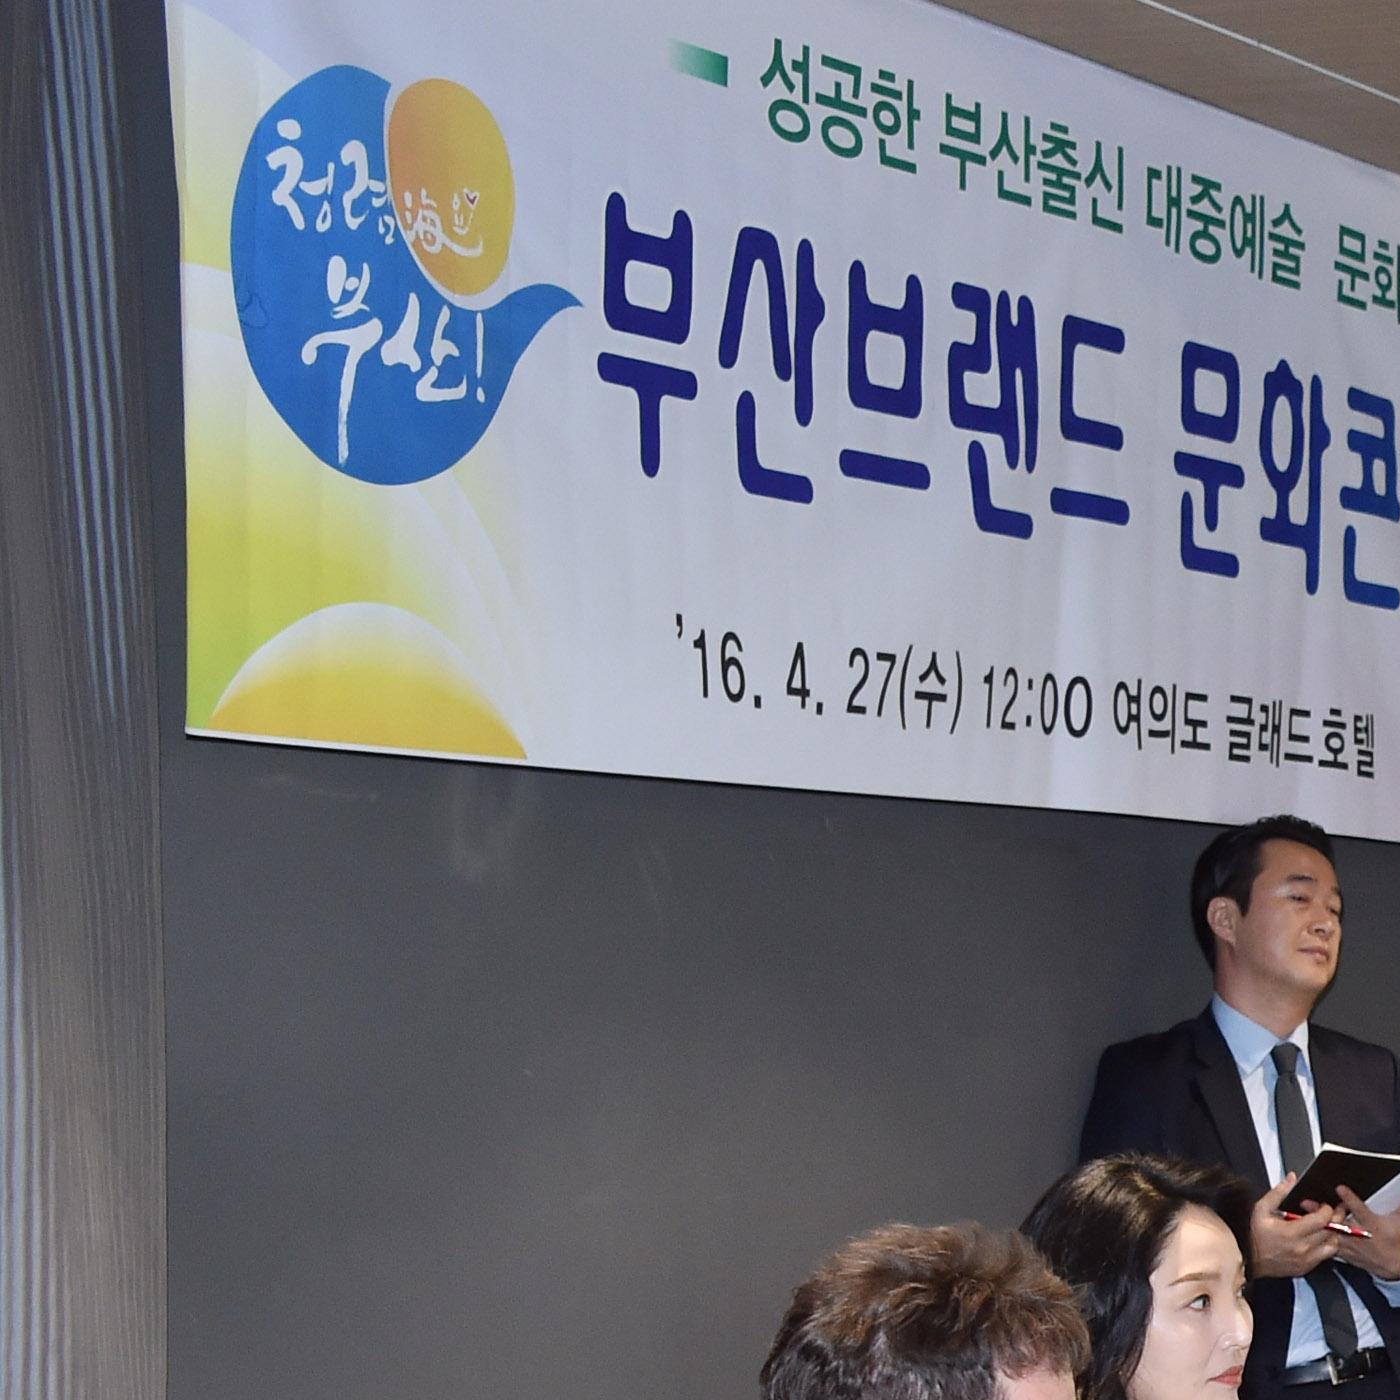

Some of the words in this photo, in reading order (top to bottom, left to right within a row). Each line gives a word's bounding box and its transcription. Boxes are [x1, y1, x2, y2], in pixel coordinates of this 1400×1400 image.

[760, 38, 920, 174] 성공한
[938, 93, 1124, 234] 부산출신
[1146, 165, 1305, 290] 대중예술
[301, 255, 486, 467] 부산!
[597, 191, 1131, 541] 부산브랜드
[786, 641, 824, 716] 4.
[846, 644, 963, 735] 27(수)
[983, 665, 1093, 739] 12:00
[1113, 678, 1212, 755] 여의도
